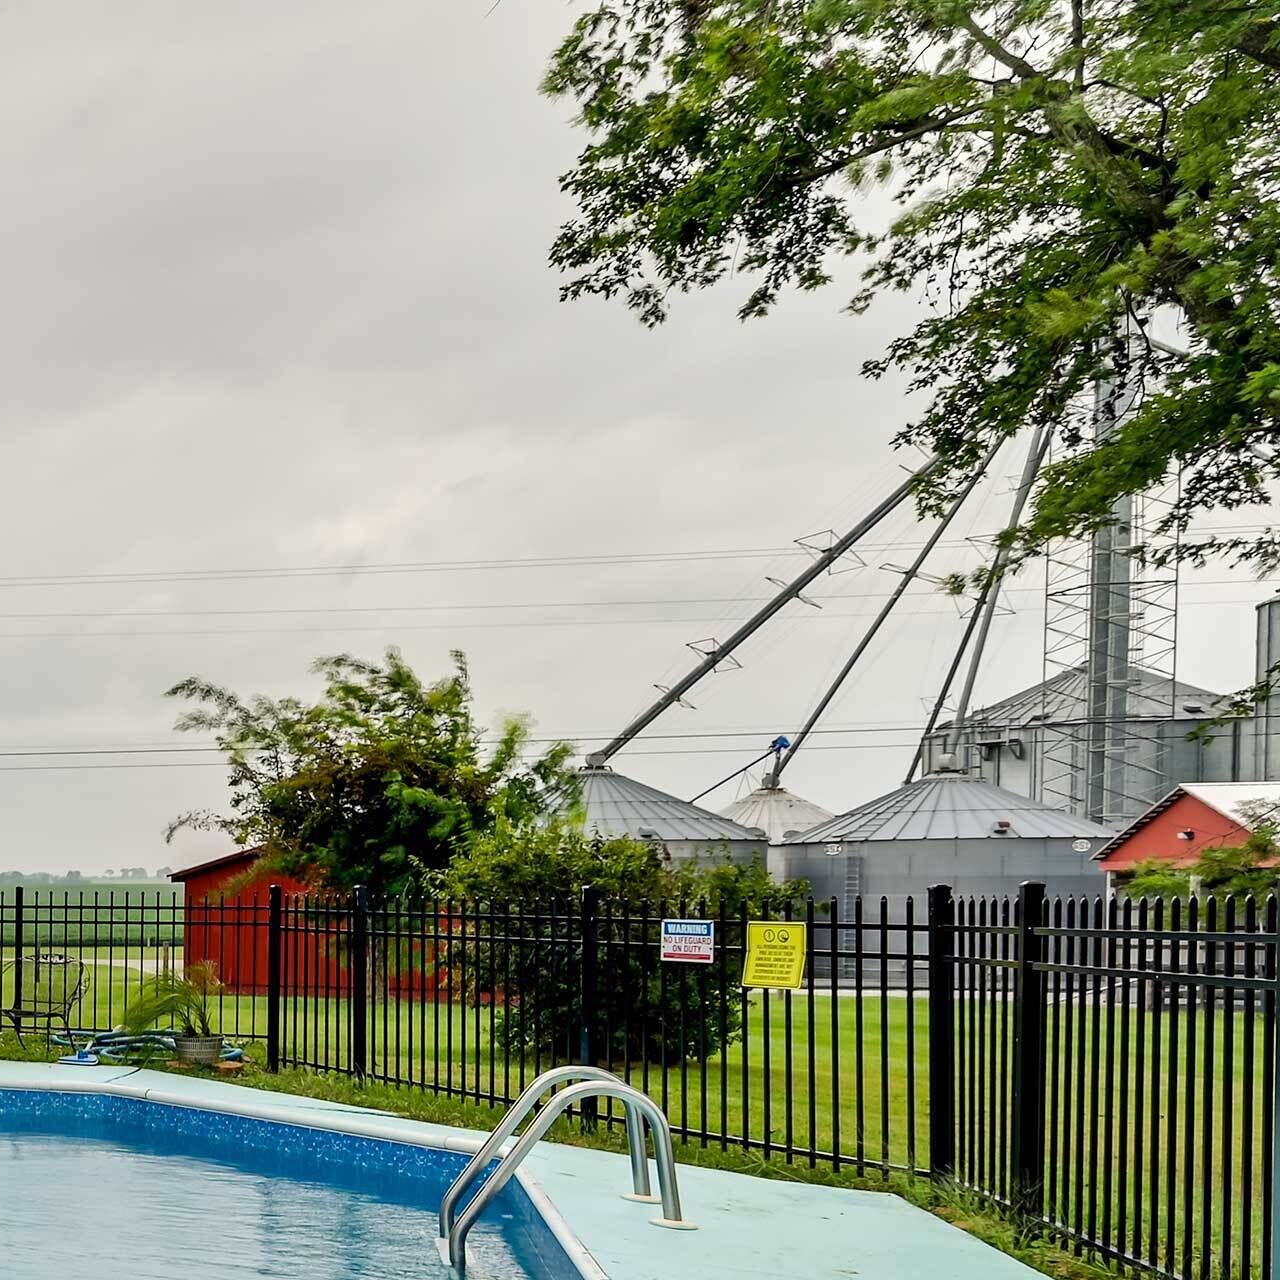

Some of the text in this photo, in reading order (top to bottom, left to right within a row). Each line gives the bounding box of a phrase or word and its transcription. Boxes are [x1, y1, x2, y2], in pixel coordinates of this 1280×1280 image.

[667, 924, 707, 935] WARNING
[664, 936, 712, 945] NO LIFEGUARD
